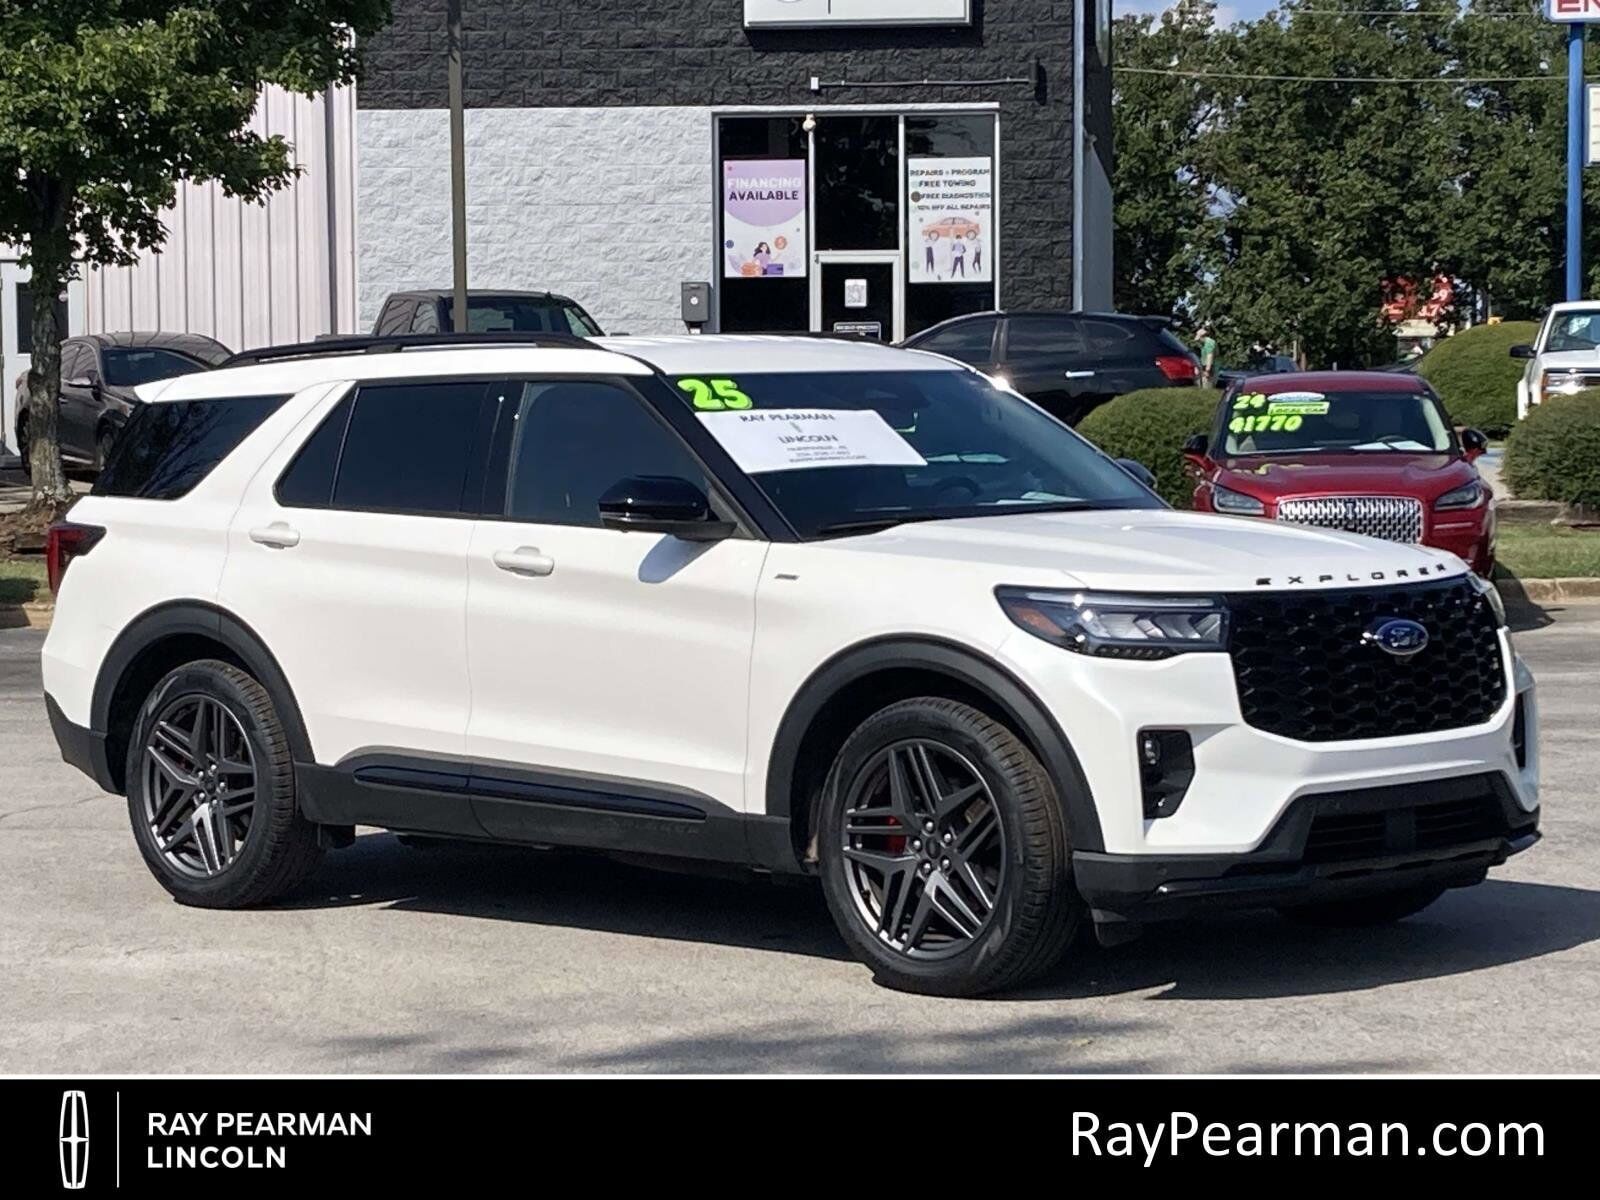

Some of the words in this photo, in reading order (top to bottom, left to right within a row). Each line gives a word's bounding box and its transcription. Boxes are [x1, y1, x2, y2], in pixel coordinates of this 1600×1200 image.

[727, 177, 802, 189] FINANCING
[942, 179, 976, 187] TOWING
[729, 190, 799, 201] AVAILABLE
[677, 379, 753, 410] 25
[739, 414, 765, 422] RAY
[768, 413, 836, 421] PEARMAN
[778, 434, 839, 444] LINCOLN
[1256, 563, 1446, 585] EXPLORER
